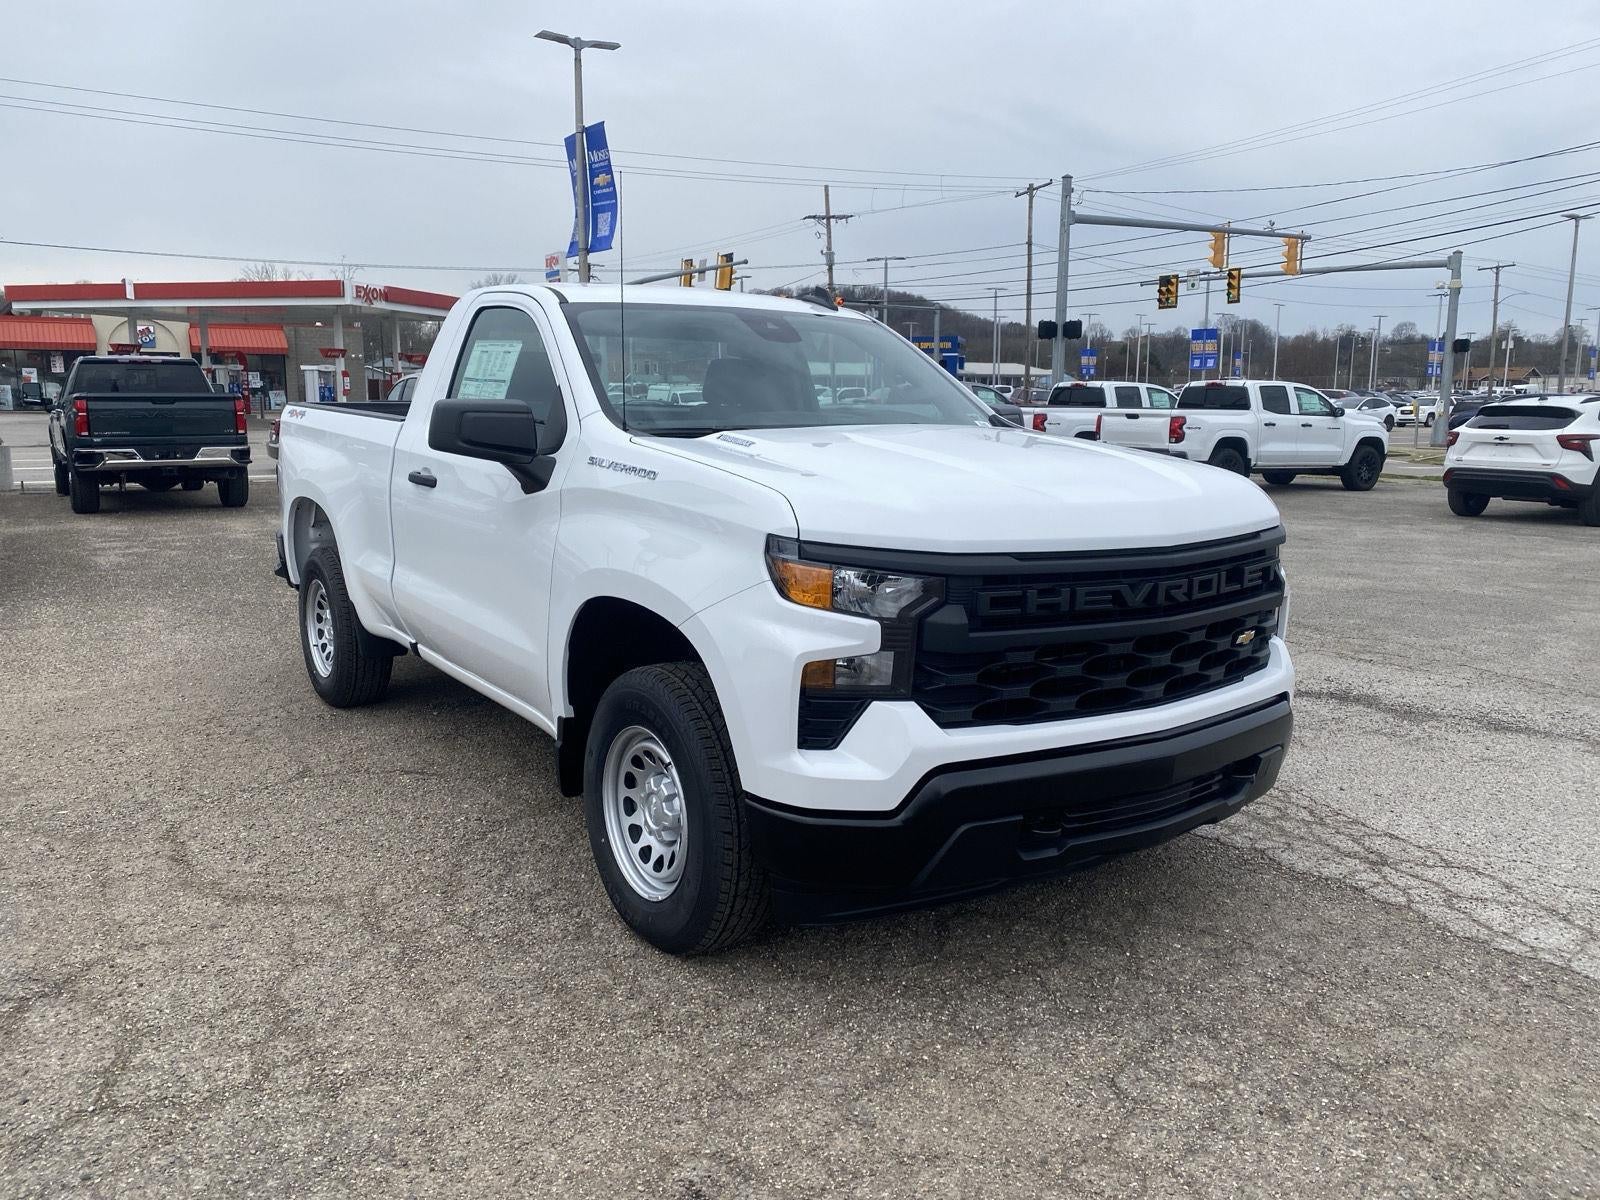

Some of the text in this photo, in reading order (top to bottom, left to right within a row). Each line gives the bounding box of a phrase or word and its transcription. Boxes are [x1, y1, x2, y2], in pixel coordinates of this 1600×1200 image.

[355, 284, 389, 305] EXXON
[587, 456, 658, 481] SILVERADO
[976, 560, 1280, 616] CHEVROLET
